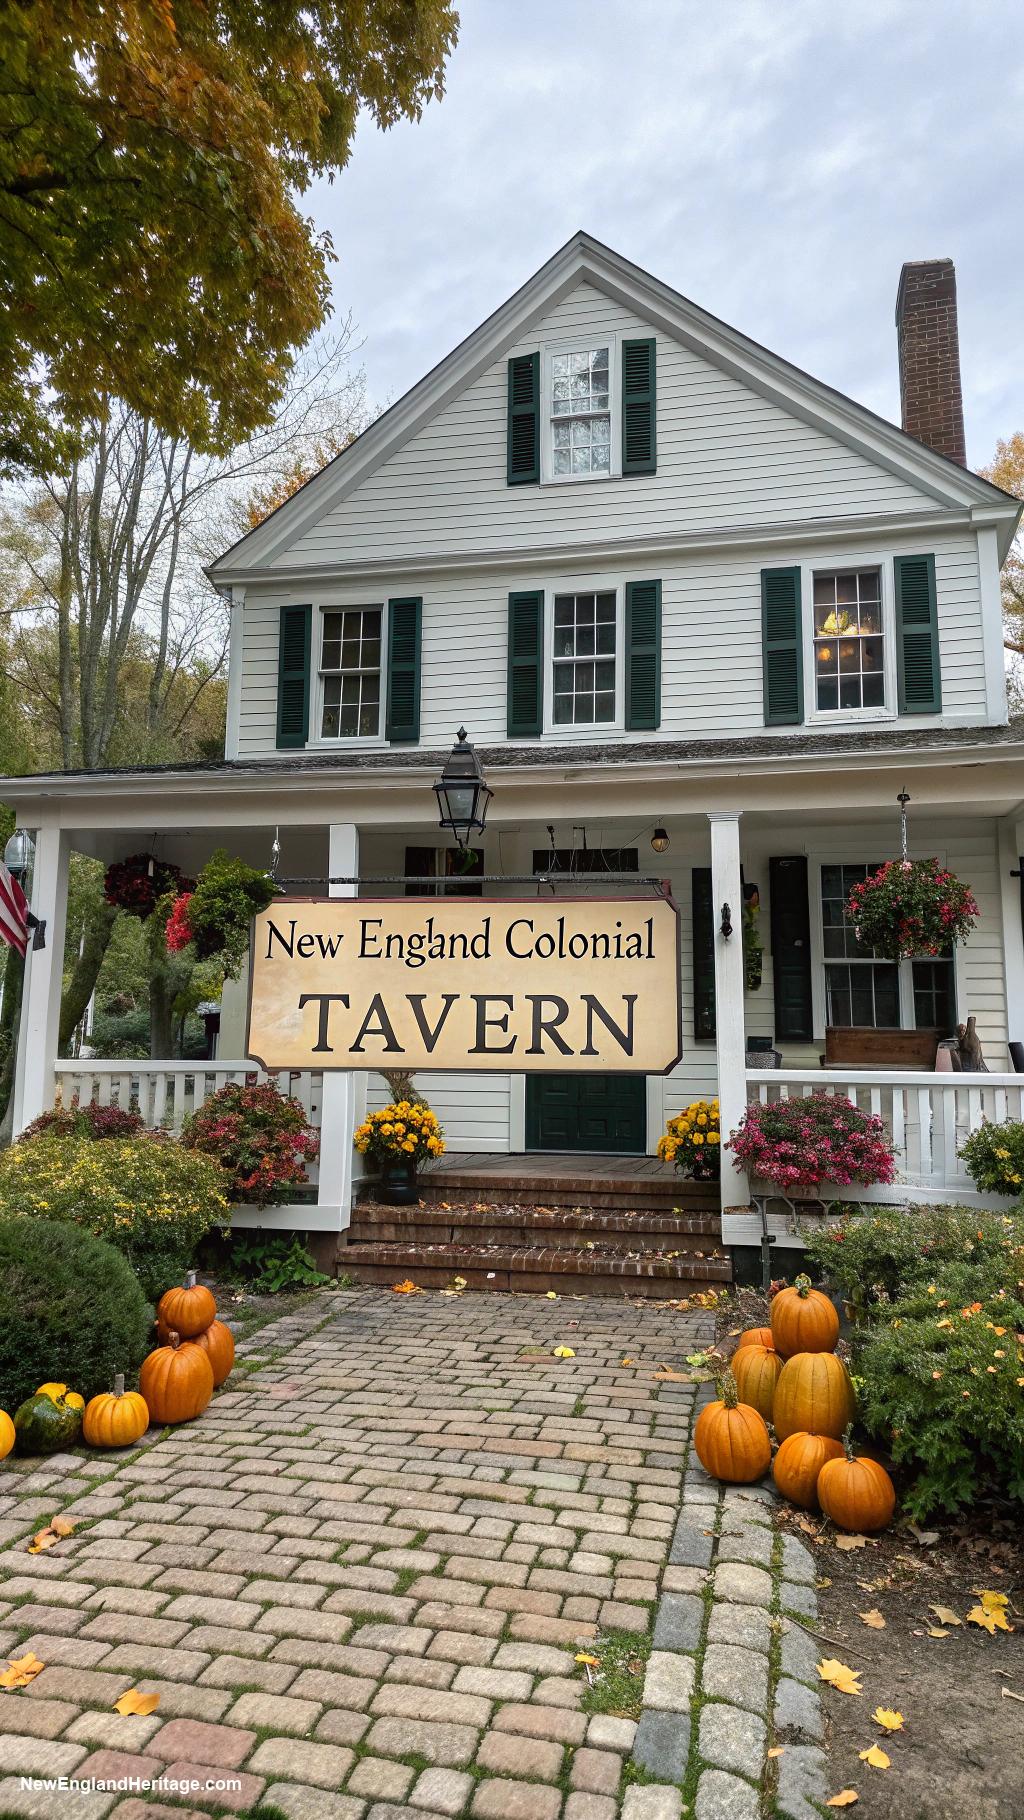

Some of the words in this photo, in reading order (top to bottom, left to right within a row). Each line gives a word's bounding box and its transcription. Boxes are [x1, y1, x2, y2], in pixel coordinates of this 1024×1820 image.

[265, 920, 343, 960] New
[358, 916, 492, 968] England
[505, 916, 656, 960] Colonial
[299, 993, 639, 1057] TAVERN
